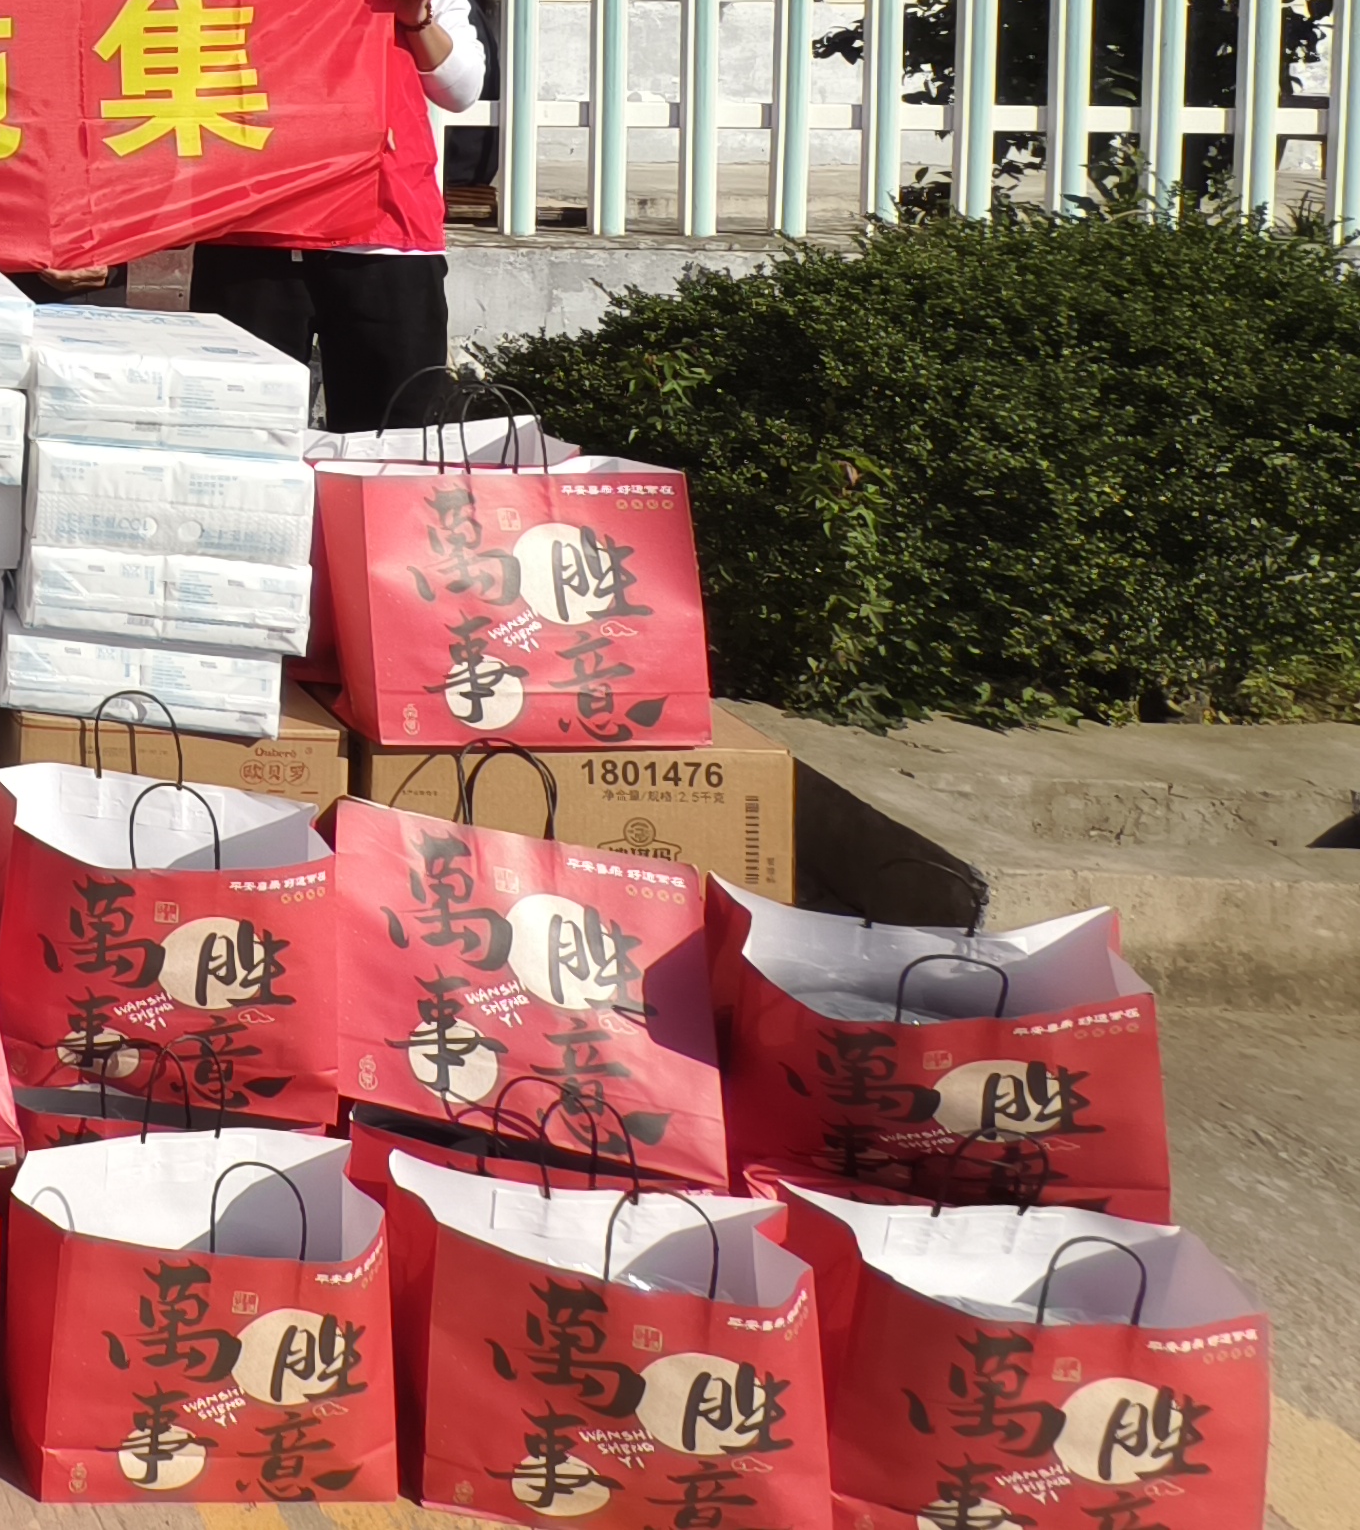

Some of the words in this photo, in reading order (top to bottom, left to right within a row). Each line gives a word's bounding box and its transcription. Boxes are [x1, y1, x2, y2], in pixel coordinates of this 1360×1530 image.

[520, 638, 539, 653] YI
[581, 759, 724, 788] 1801476
[145, 1016, 166, 1031] YI
[499, 1011, 522, 1027] YI
[214, 1412, 237, 1429] YI
[617, 1456, 645, 1469] YI
